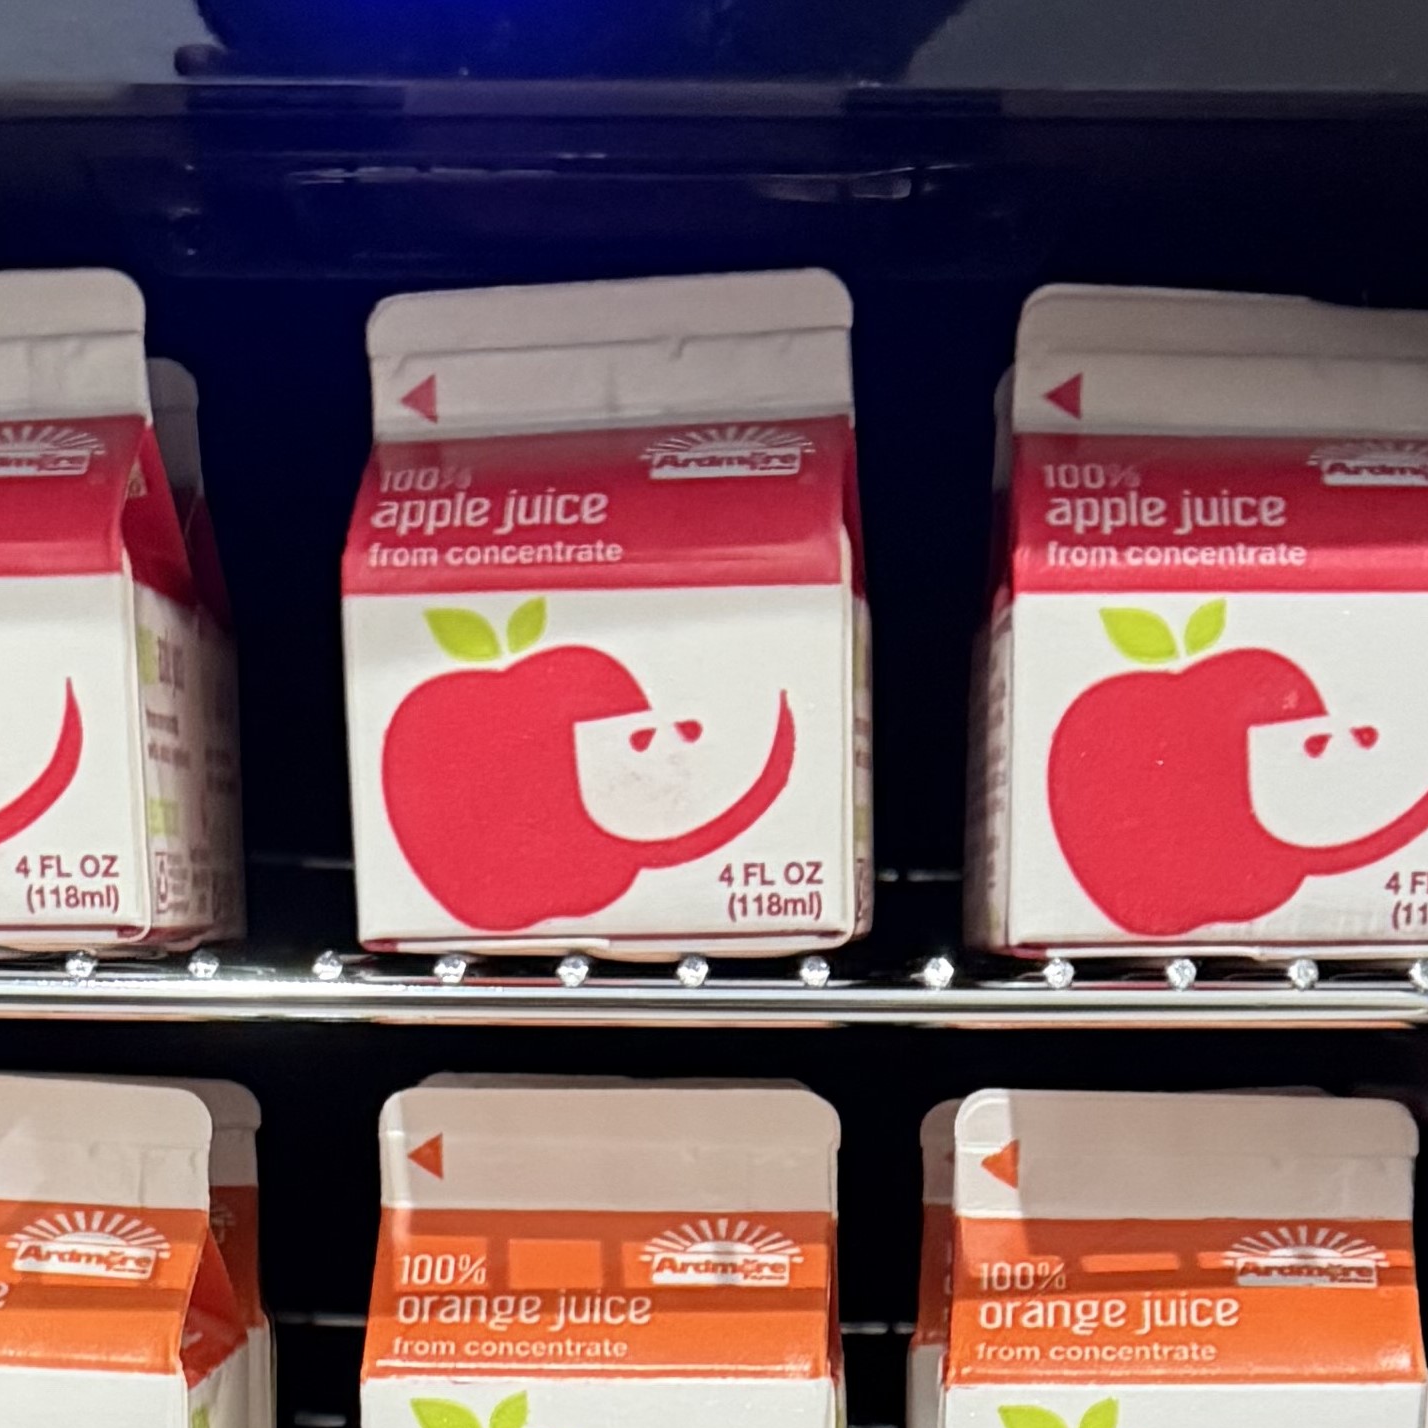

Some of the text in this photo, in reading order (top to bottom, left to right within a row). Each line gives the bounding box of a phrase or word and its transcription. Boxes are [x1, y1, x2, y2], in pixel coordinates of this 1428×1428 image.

[381, 466, 472, 493] 100%
[1043, 464, 1141, 489] 100%
[371, 487, 608, 536] apple juice
[1045, 489, 1287, 535] apple juice
[368, 540, 623, 567] from concentrate
[1047, 541, 1307, 566] from concentrate
[15, 854, 119, 879] 4 FL OZ
[718, 861, 823, 887] 4 FL OZ
[1384, 872, 1401, 895] 4
[26, 884, 119, 914] (118ml)
[728, 891, 822, 922] (118ml)
[399, 1254, 487, 1286] 100%
[979, 1262, 1066, 1291] 100%
[397, 1289, 652, 1332] orange juice
[979, 1291, 1240, 1335] orange juice
[392, 1337, 629, 1358] from concentrate
[976, 1342, 1218, 1361] from concentrate
